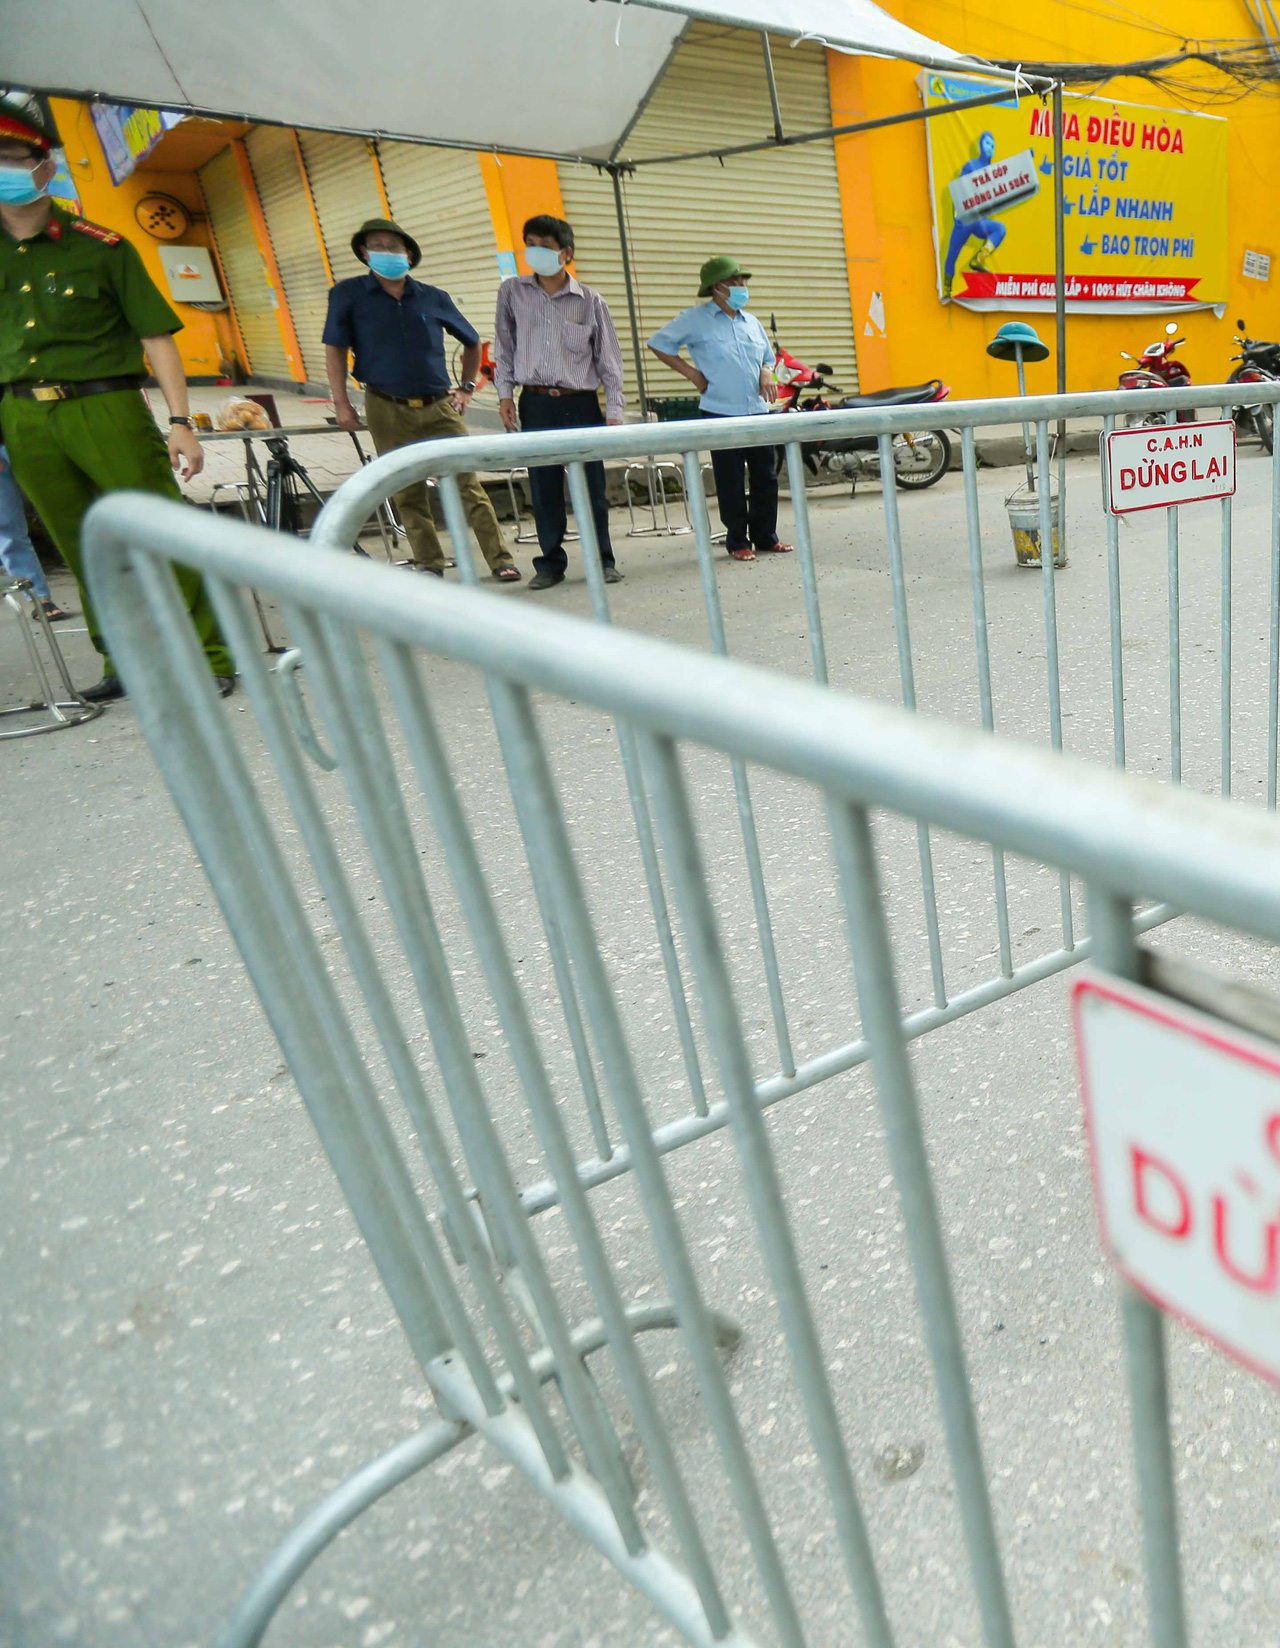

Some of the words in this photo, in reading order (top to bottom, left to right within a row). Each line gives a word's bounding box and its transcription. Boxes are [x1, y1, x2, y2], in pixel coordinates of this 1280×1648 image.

[1087, 104, 1135, 147] ĐIỀU
[1141, 118, 1184, 154] HÒA
[992, 164, 1008, 179] GÓP
[1062, 150, 1092, 178] GIÁ
[1097, 149, 1130, 181] TỐT
[962, 192, 992, 211] KHÔNG
[1078, 184, 1111, 216] LẮP
[1115, 197, 1174, 221] NHANH
[1101, 233, 1131, 256] BAO
[1134, 235, 1170, 263] TRỌN
[1172, 232, 1194, 258] PHÍ
[995, 275, 1020, 296] MIỄN
[1021, 278, 1038, 296] PHÍ
[1092, 283, 1115, 297] 100%
[1147, 434, 1202, 452] C.A.H.N
[1120, 458, 1187, 490] DỪNG
[1191, 456, 1227, 483] LẠI
